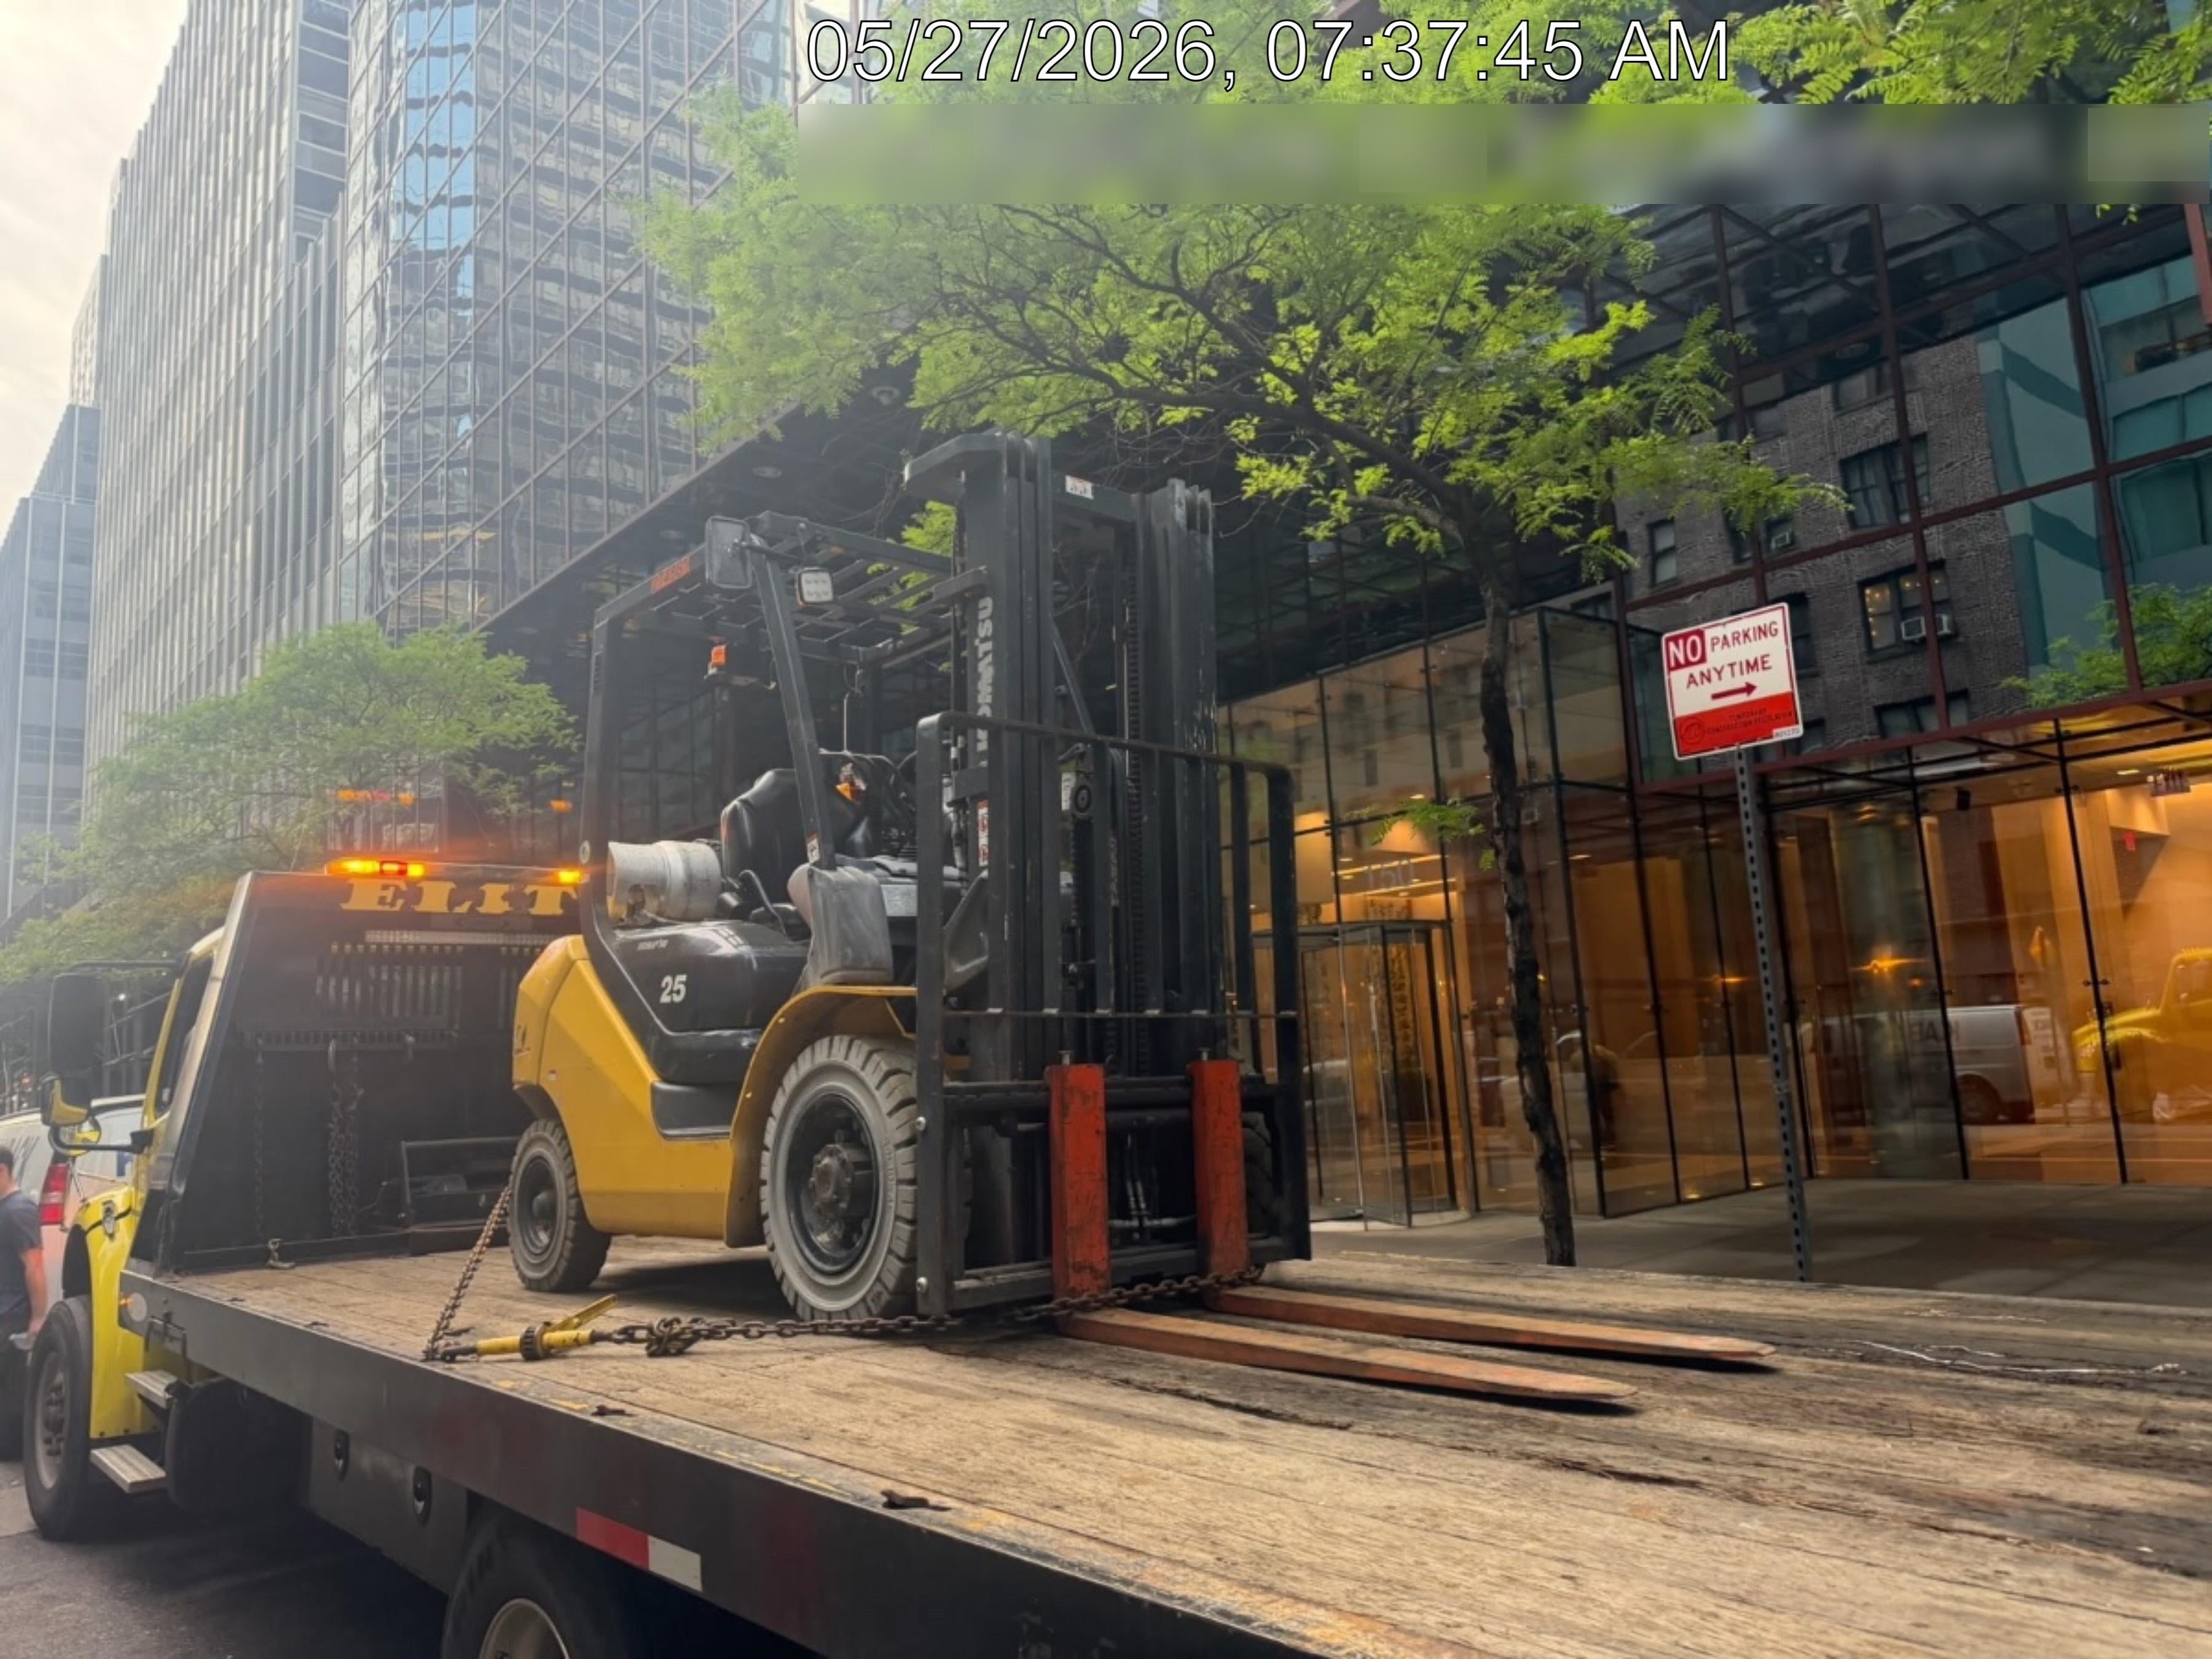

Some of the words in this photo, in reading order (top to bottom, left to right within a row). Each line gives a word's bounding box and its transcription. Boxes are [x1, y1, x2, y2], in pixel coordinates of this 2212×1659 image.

[1668, 635, 1703, 668] NO
[1711, 621, 1778, 653] PARKING
[1686, 654, 1772, 689] ANYTIME
[659, 975, 688, 1003] 25
